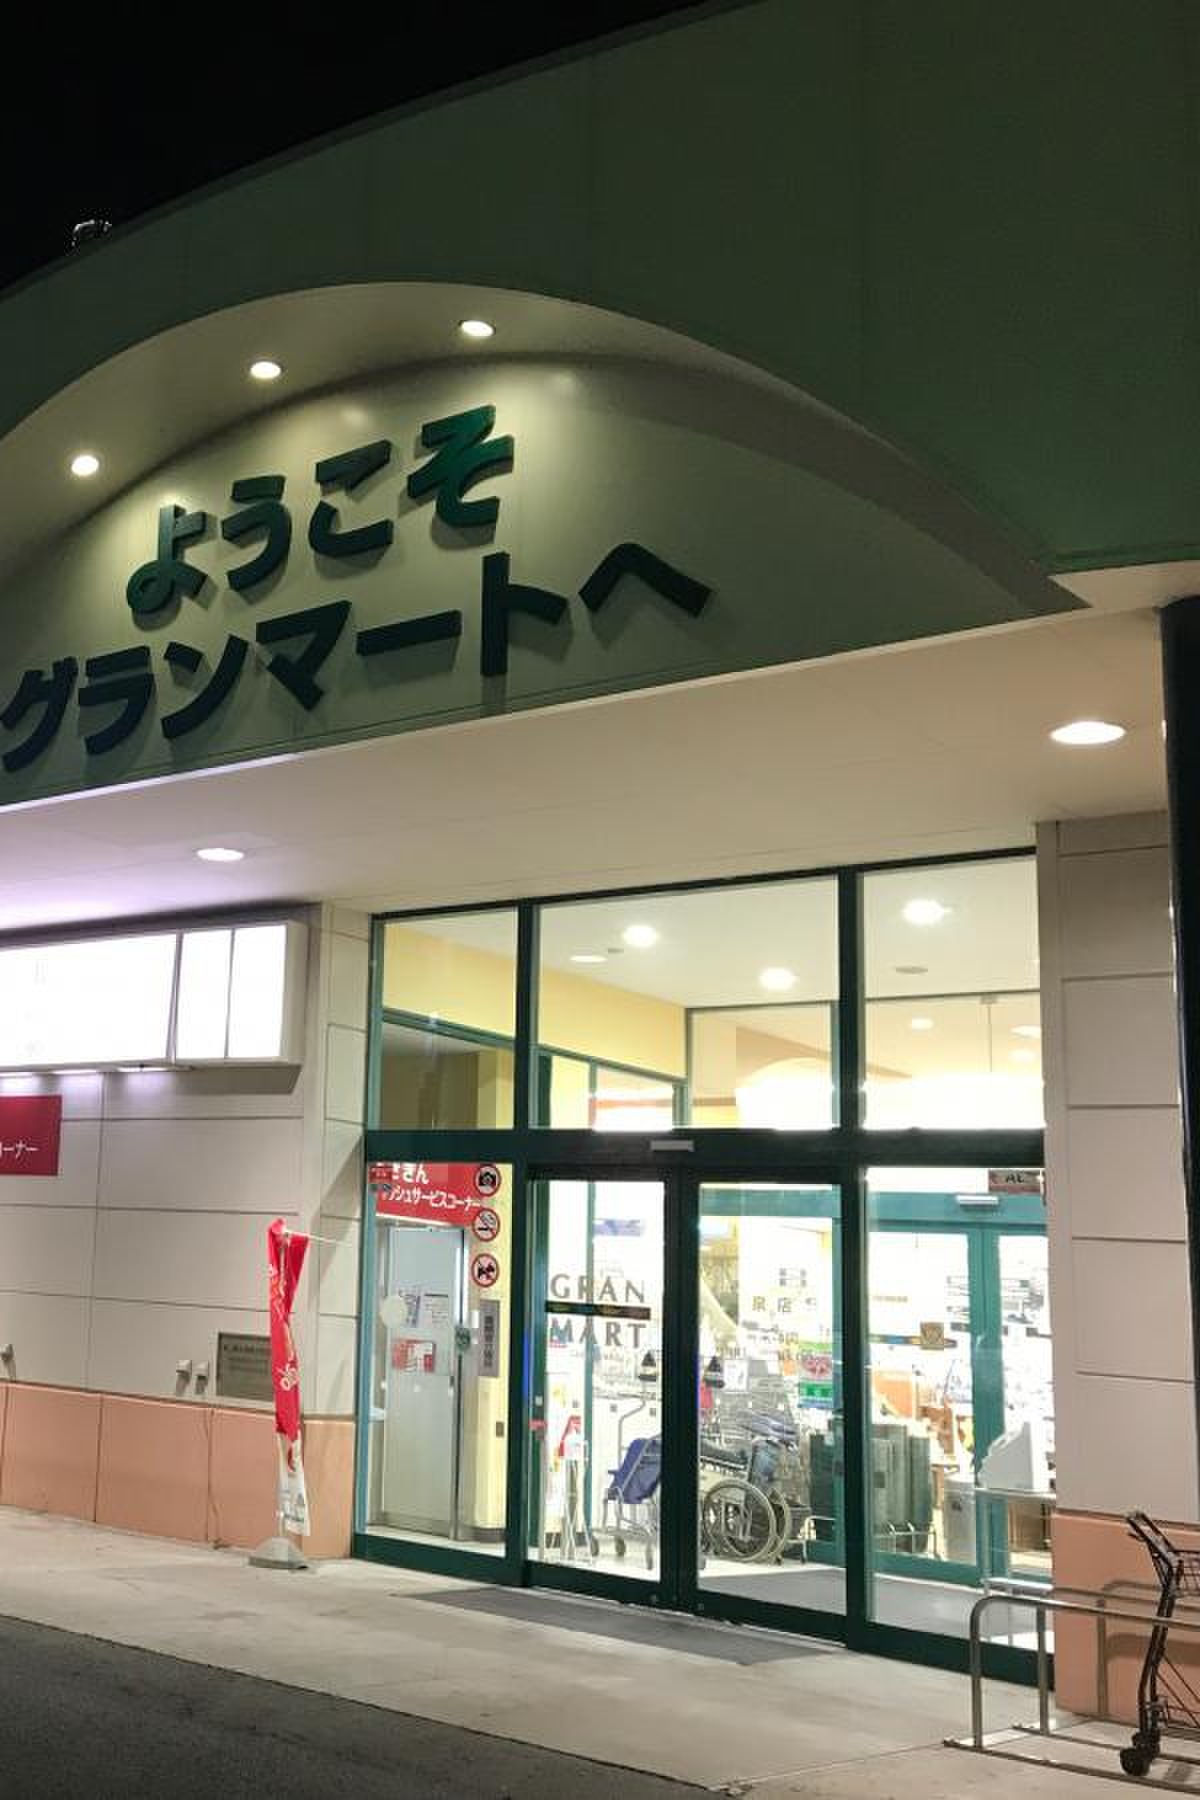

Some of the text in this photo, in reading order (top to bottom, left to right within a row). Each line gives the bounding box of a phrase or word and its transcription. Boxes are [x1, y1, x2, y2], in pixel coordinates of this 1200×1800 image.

[126, 404, 515, 613] ようこそ
[0, 542, 716, 773] グランマートへ
[549, 1317, 647, 1349] MART
[550, 1273, 645, 1303] GRAN
